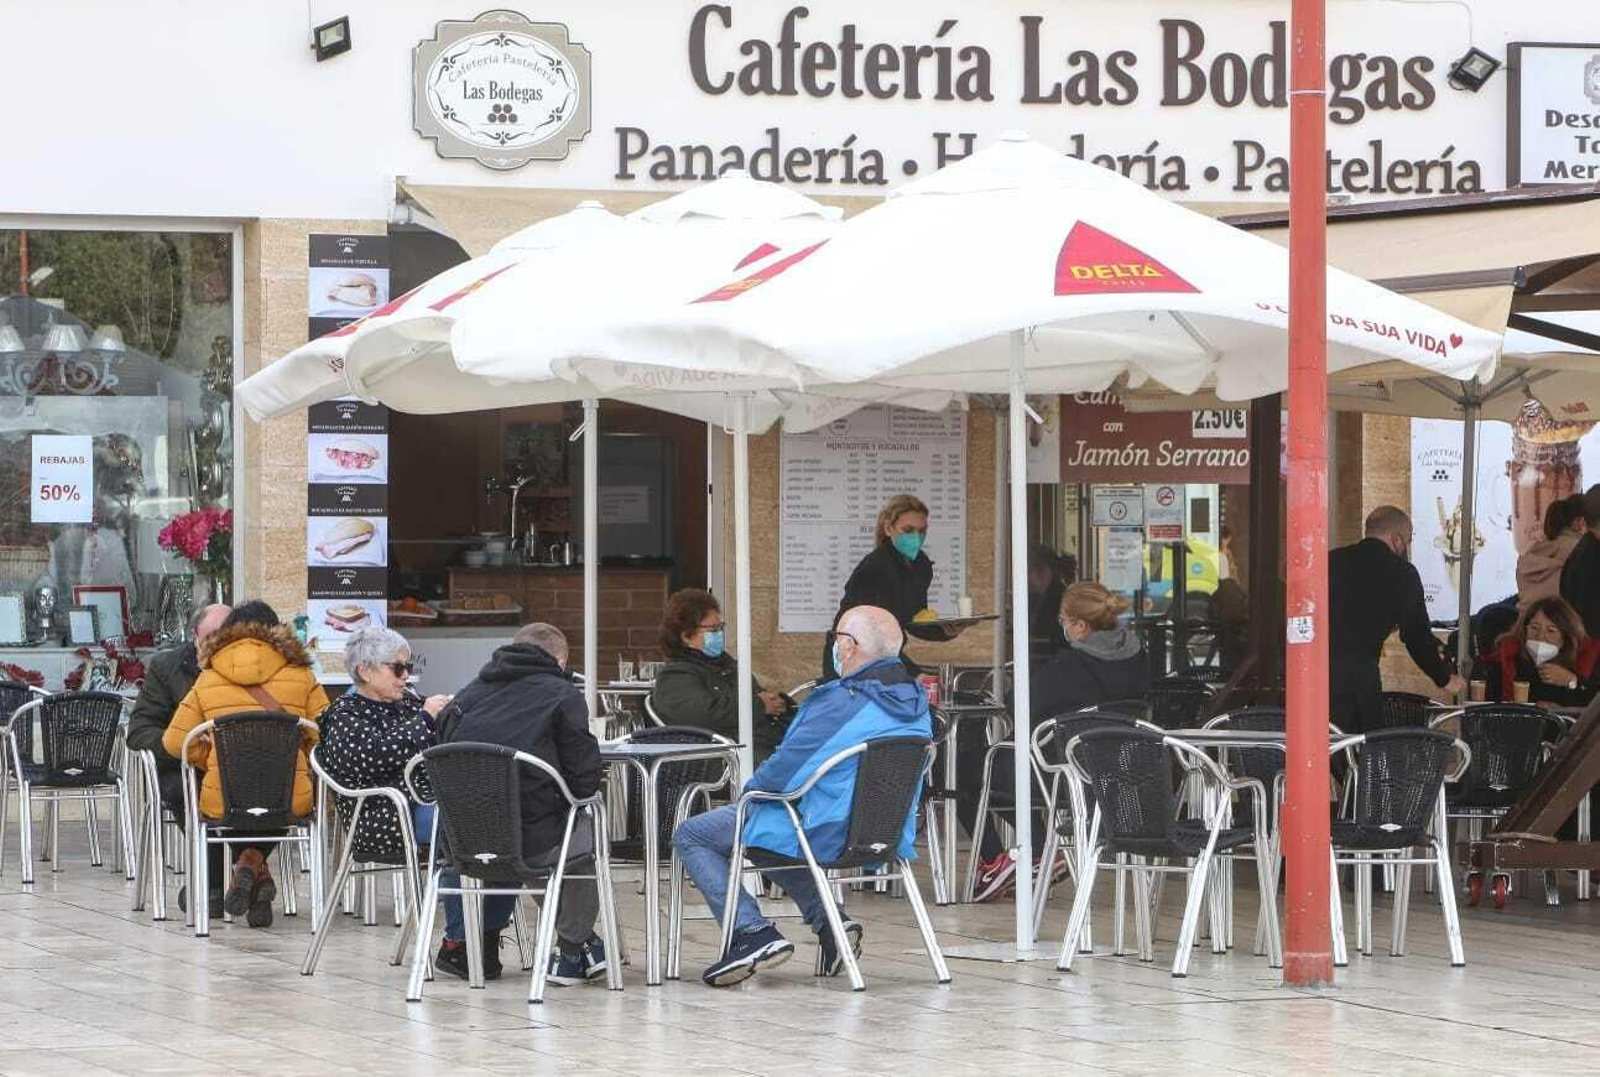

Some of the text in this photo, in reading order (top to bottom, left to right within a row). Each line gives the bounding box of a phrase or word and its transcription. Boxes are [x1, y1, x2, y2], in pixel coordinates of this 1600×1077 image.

[689, 5, 1436, 125] Cafetería Las Bodgas
[464, 80, 544, 105] Las Bodegas
[615, 128, 888, 184] Panadería
[1232, 139, 1486, 195] Patelería
[1070, 263, 1164, 279] DELTA
[1363, 319, 1401, 341] SUA
[1405, 328, 1449, 358] VIDA
[1103, 421, 1123, 433] con
[40, 456, 85, 465] REBAJAS
[1069, 440, 1250, 467] Jamón Serrano
[40, 485, 80, 501] 50%
